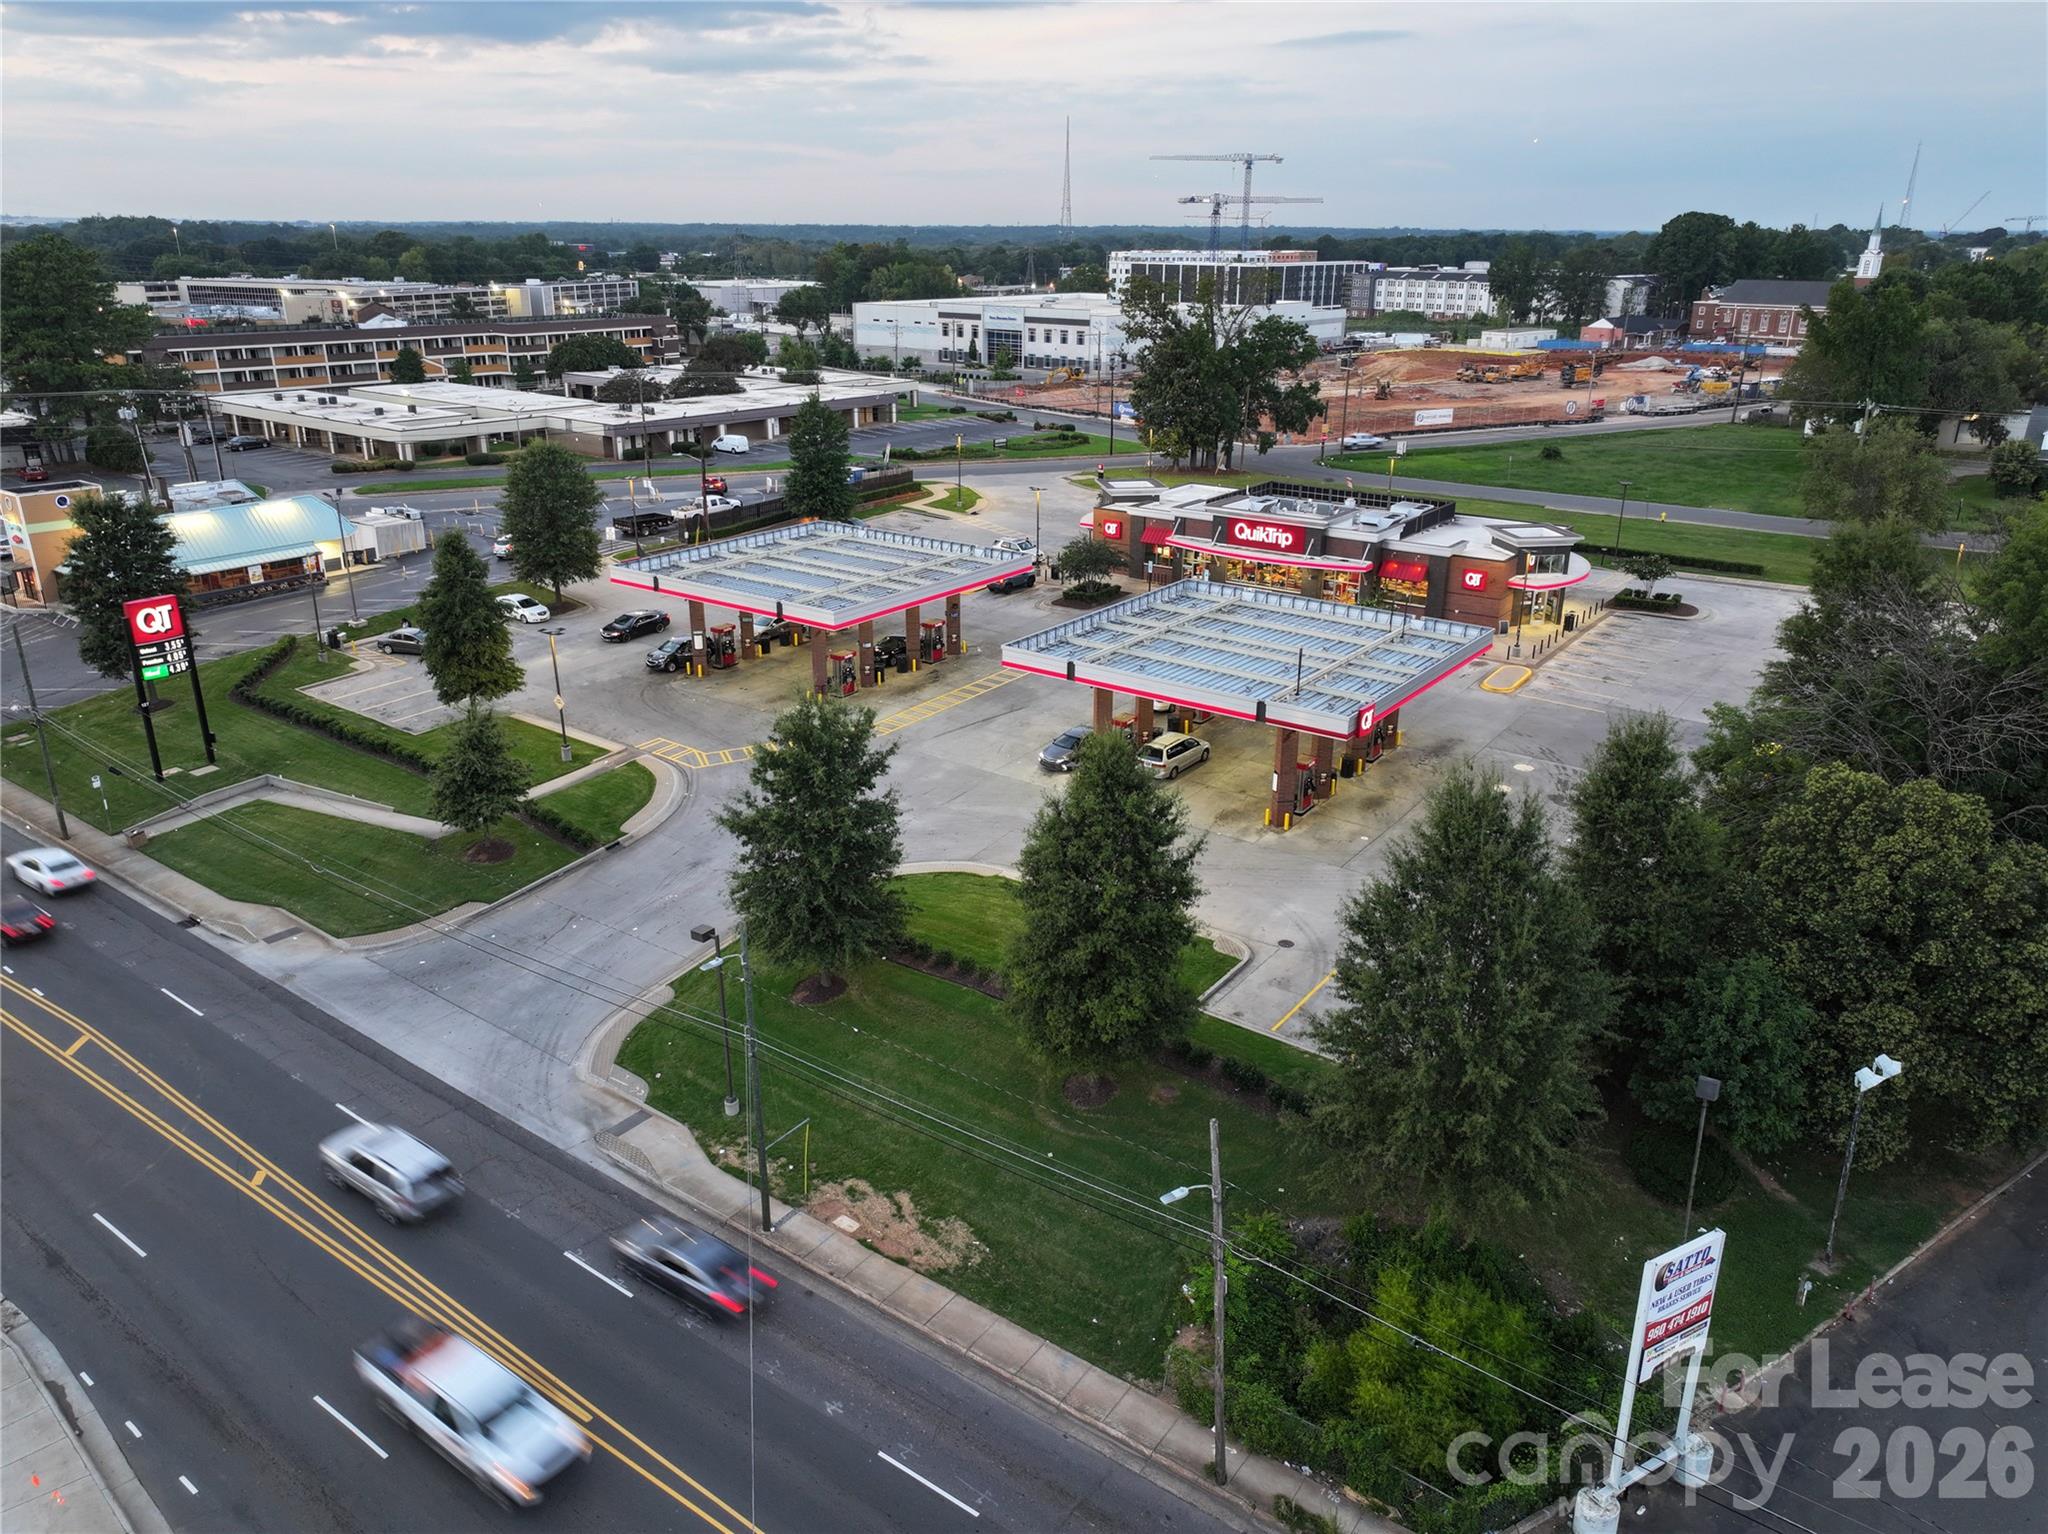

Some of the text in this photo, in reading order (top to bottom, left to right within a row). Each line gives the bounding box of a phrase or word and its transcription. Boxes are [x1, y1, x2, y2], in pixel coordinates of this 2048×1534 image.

[1105, 522, 1118, 535] QT
[1234, 522, 1293, 548] QuikTrip
[1465, 572, 1483, 587] QT
[136, 604, 173, 634] QT
[1361, 708, 1375, 730] QT
[1665, 1246, 1712, 1278] SATTO
[1651, 1294, 1669, 1309] NEW
[1674, 1282, 1692, 1297] USED
[1692, 1272, 1713, 1288] TIRES
[1647, 1322, 1665, 1342] 980
[1667, 1312, 1685, 1330] 474
[1686, 1301, 1709, 1322] 1910
